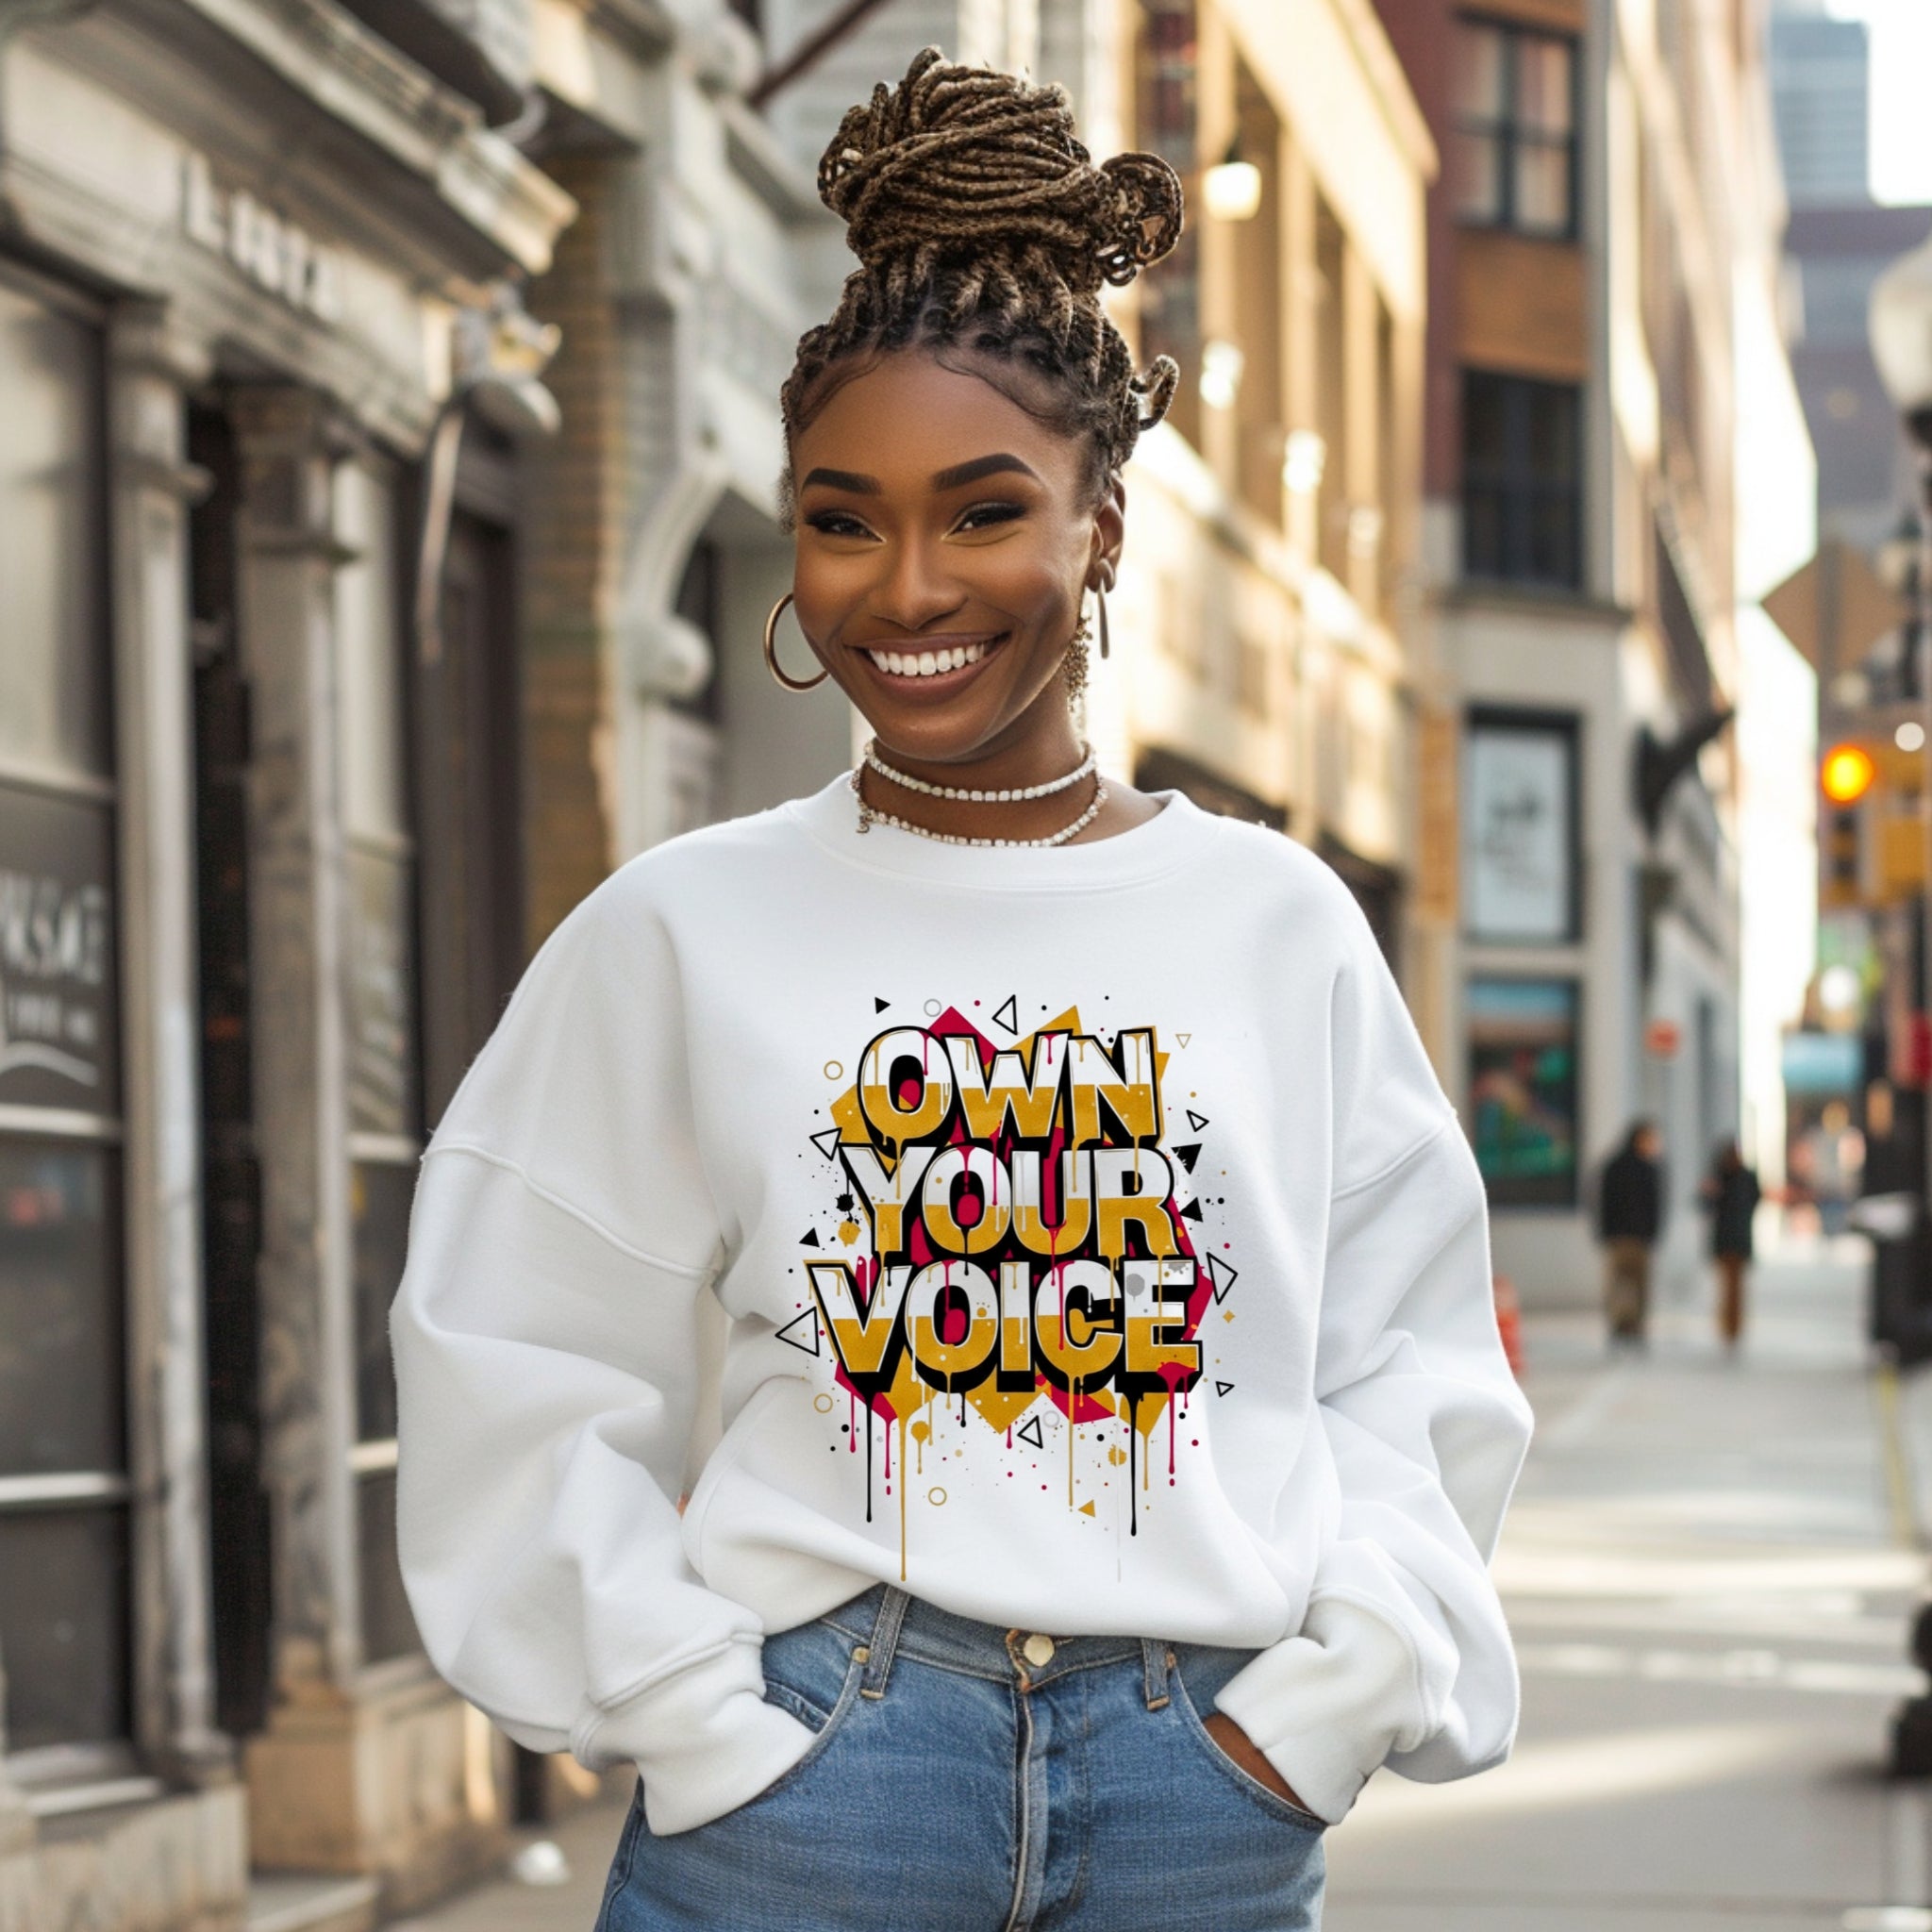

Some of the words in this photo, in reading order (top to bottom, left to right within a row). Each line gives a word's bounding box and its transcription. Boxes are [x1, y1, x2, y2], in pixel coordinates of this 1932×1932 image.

[858, 1025, 1161, 1142] OWN
[841, 1141, 1179, 1258] YOUR
[808, 1259, 1202, 1391] VOICE
